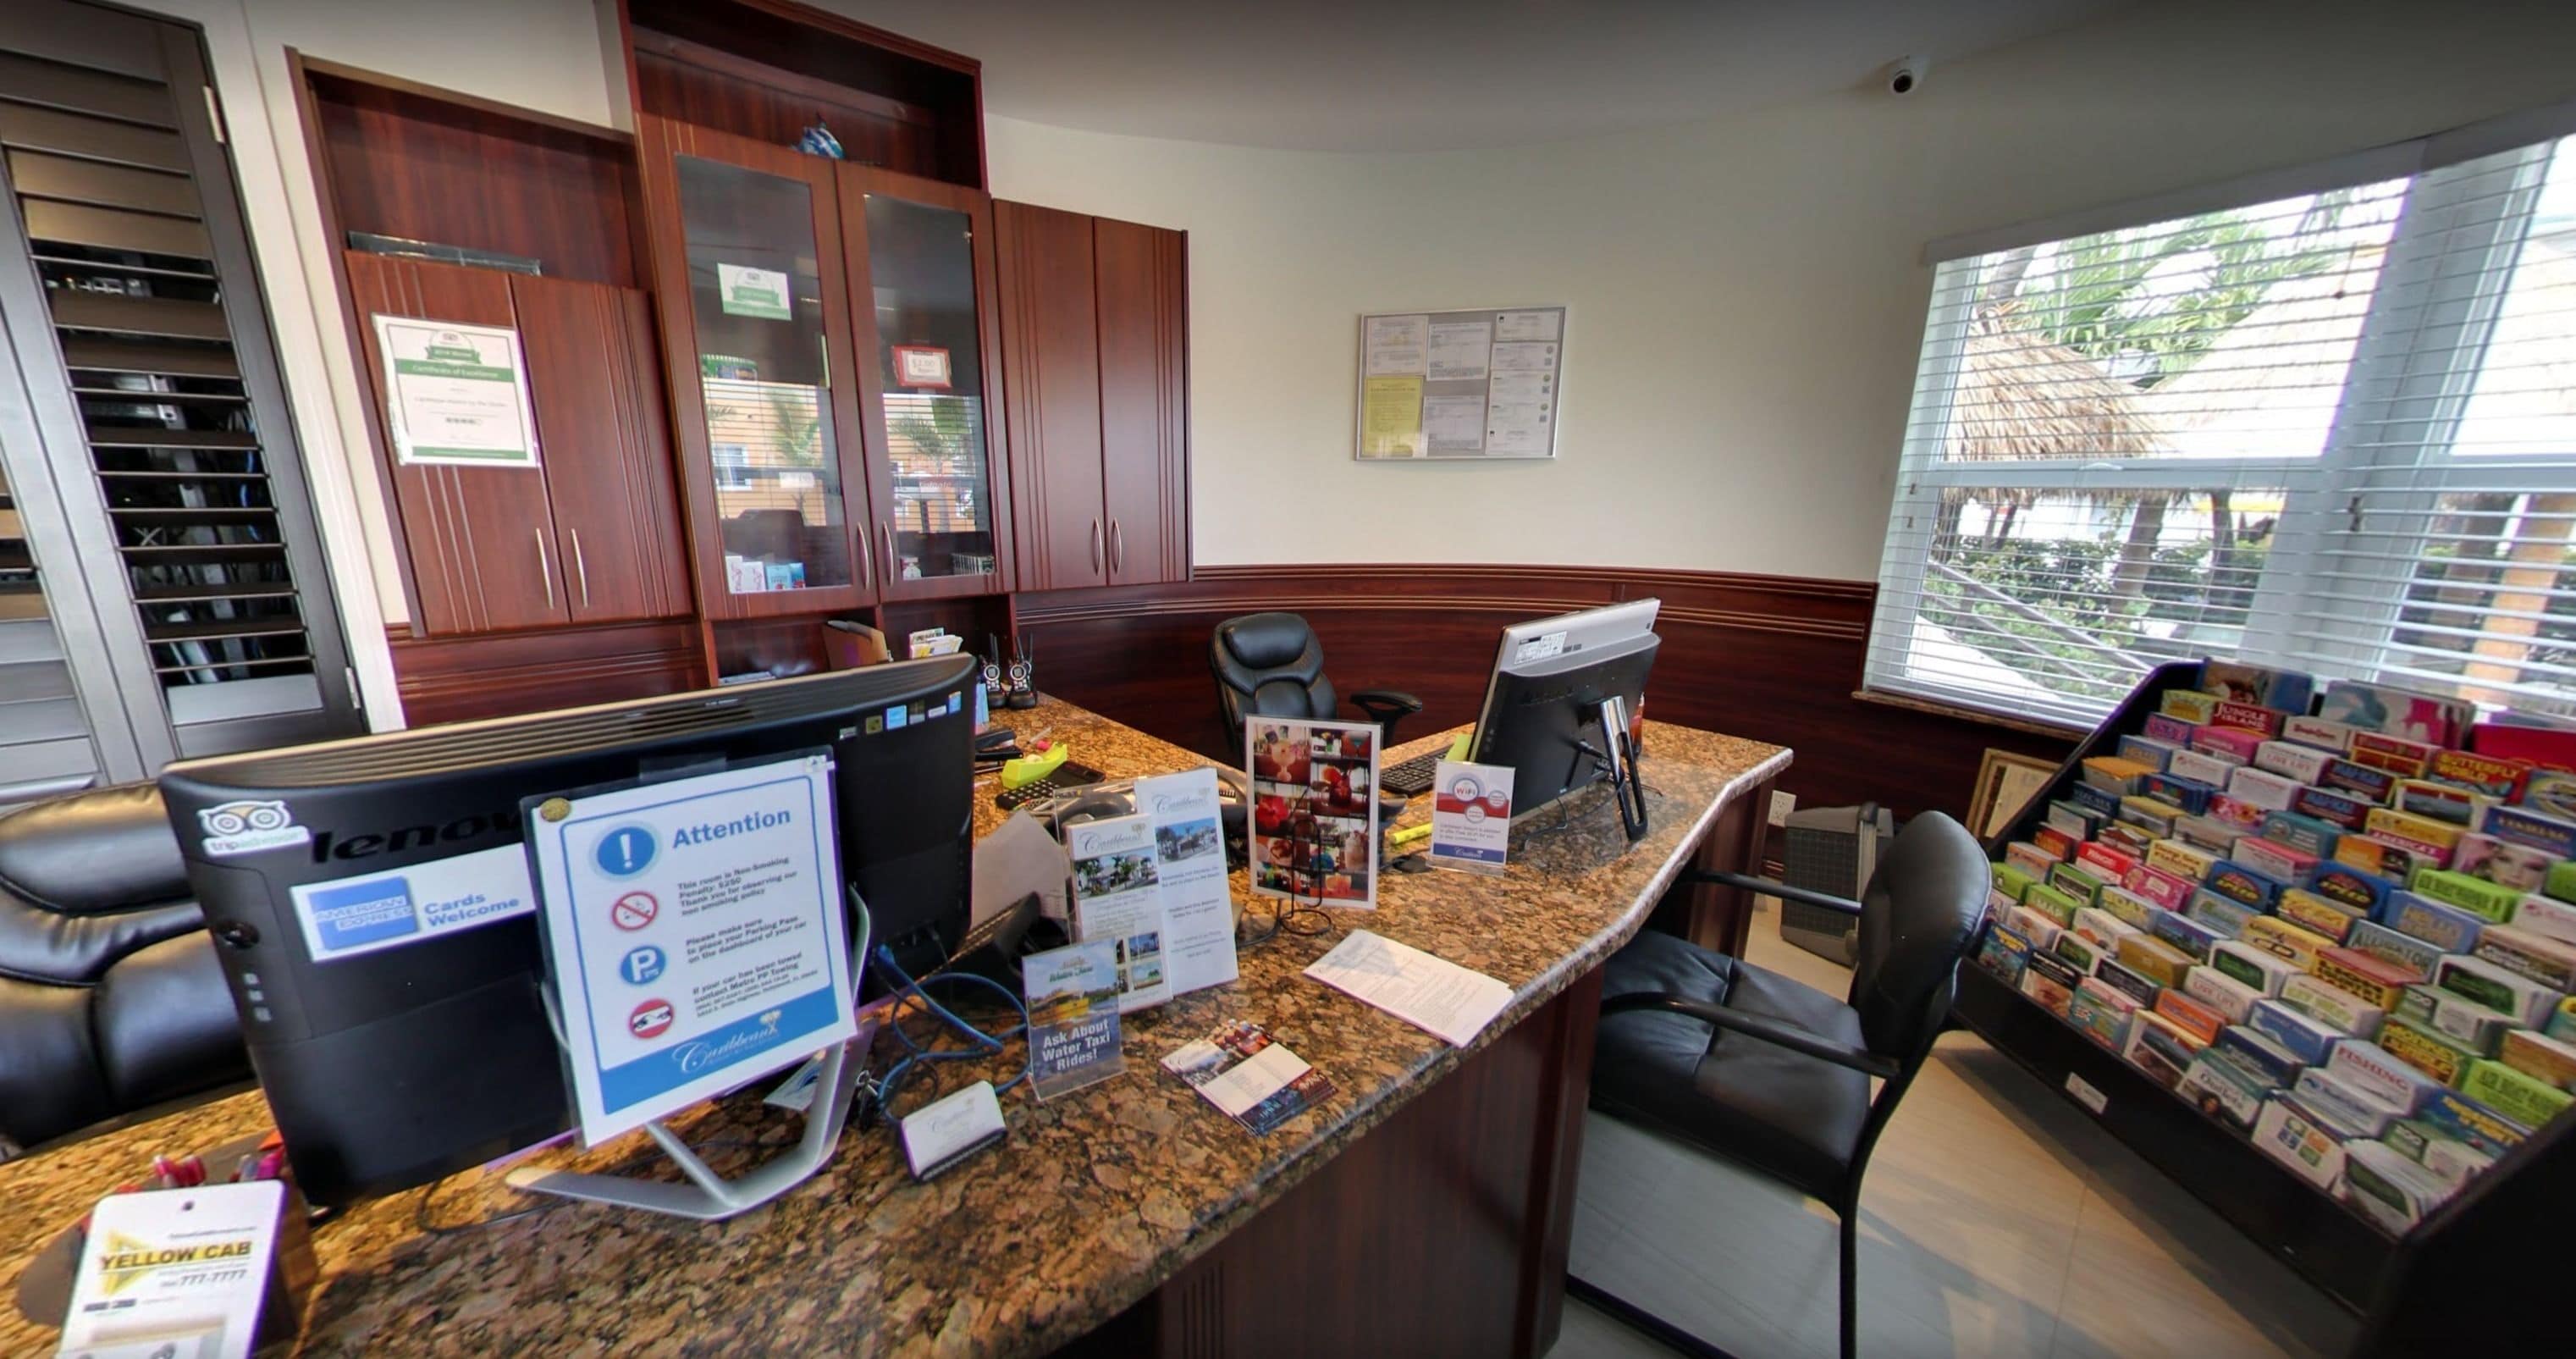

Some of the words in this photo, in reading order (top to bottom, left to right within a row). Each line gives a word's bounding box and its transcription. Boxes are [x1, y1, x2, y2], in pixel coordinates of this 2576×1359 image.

[2214, 702, 2268, 720] JUNGLE
[2220, 713, 2265, 728] ISLAND
[313, 807, 524, 864] lenov
[673, 810, 791, 848] Attention
[678, 881, 697, 890] This
[700, 875, 722, 886] room
[681, 896, 709, 907] Thank
[710, 892, 726, 900] you
[728, 886, 740, 895] for
[784, 870, 798, 879] our
[718, 876, 742, 888] $250
[315, 897, 405, 920] AMERICAN
[339, 906, 414, 930] EXPRESS
[424, 893, 486, 915] Cards
[427, 898, 521, 927] Welcome
[682, 907, 699, 916] non
[701, 896, 739, 912] smoking
[686, 932, 716, 947] Please
[718, 925, 742, 936] make
[744, 919, 763, 928] sure
[687, 947, 697, 956] to
[699, 939, 723, 953] place
[725, 932, 743, 943] your
[745, 921, 777, 936] Parking
[779, 915, 798, 925] Pass
[687, 956, 700, 964] on
[702, 950, 716, 958] the
[719, 934, 764, 954] dashboard
[775, 925, 792, 936] your
[794, 921, 807, 930] car
[2352, 932, 2434, 968] ALLIGATOR
[702, 981, 720, 992] your
[722, 975, 736, 984] car
[737, 969, 753, 979] has
[754, 960, 776, 973] been
[694, 986, 729, 1004] contact
[1042, 1041, 1083, 1063] Water
[1084, 1030, 1111, 1048] Taxi
[1043, 1030, 1068, 1049] Ask
[1071, 1018, 1110, 1038] About
[1056, 1048, 1098, 1072] Rides!
[2337, 1046, 2409, 1091] FISHING
[100, 1246, 198, 1271] YELLOW
[203, 1240, 252, 1260] CAB
[179, 1268, 248, 1287] 777-7777
